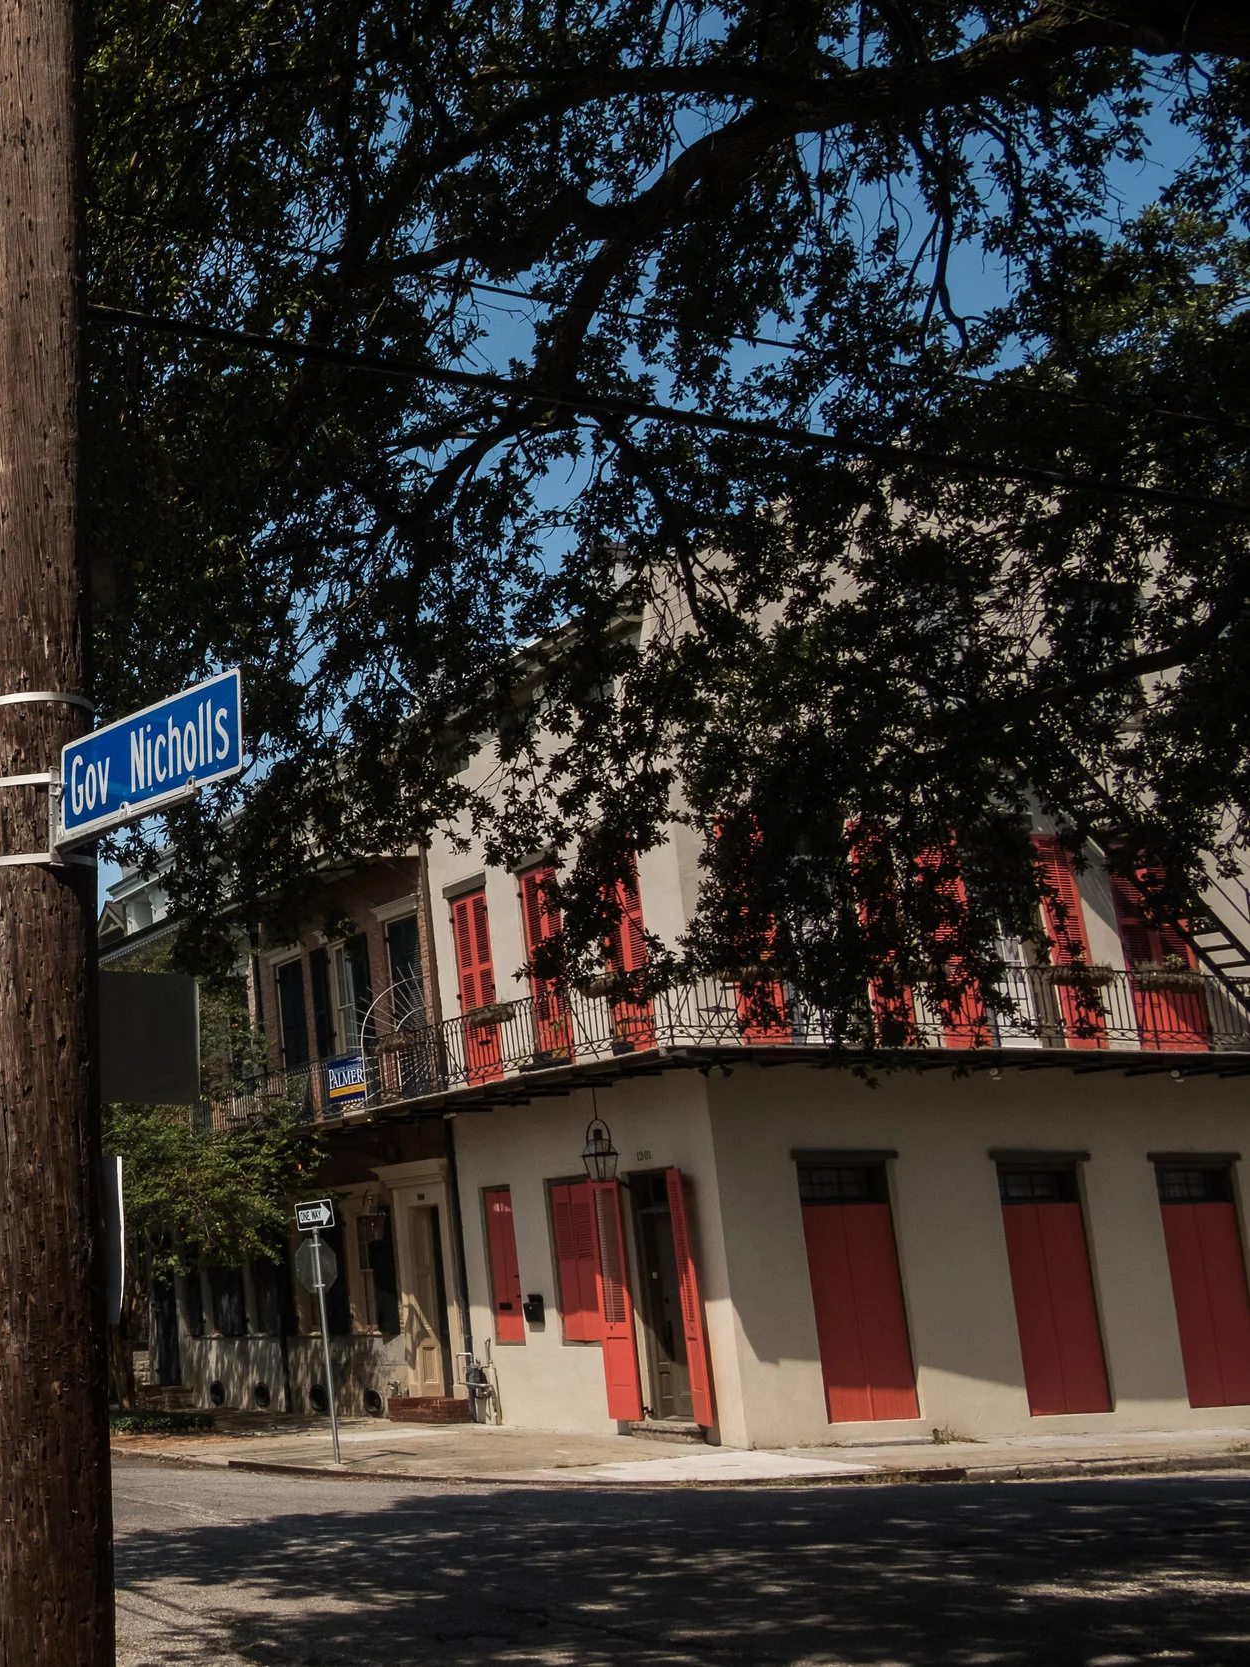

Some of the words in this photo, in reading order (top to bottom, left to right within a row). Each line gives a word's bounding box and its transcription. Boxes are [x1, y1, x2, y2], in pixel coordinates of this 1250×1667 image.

[71, 754, 111, 816] Gov
[130, 698, 230, 794] Nicholls
[328, 1068, 365, 1090] PALMER
[636, 1150, 653, 1161] 1301
[300, 1210, 311, 1222] ONE
[311, 1209, 322, 1220] WAY
